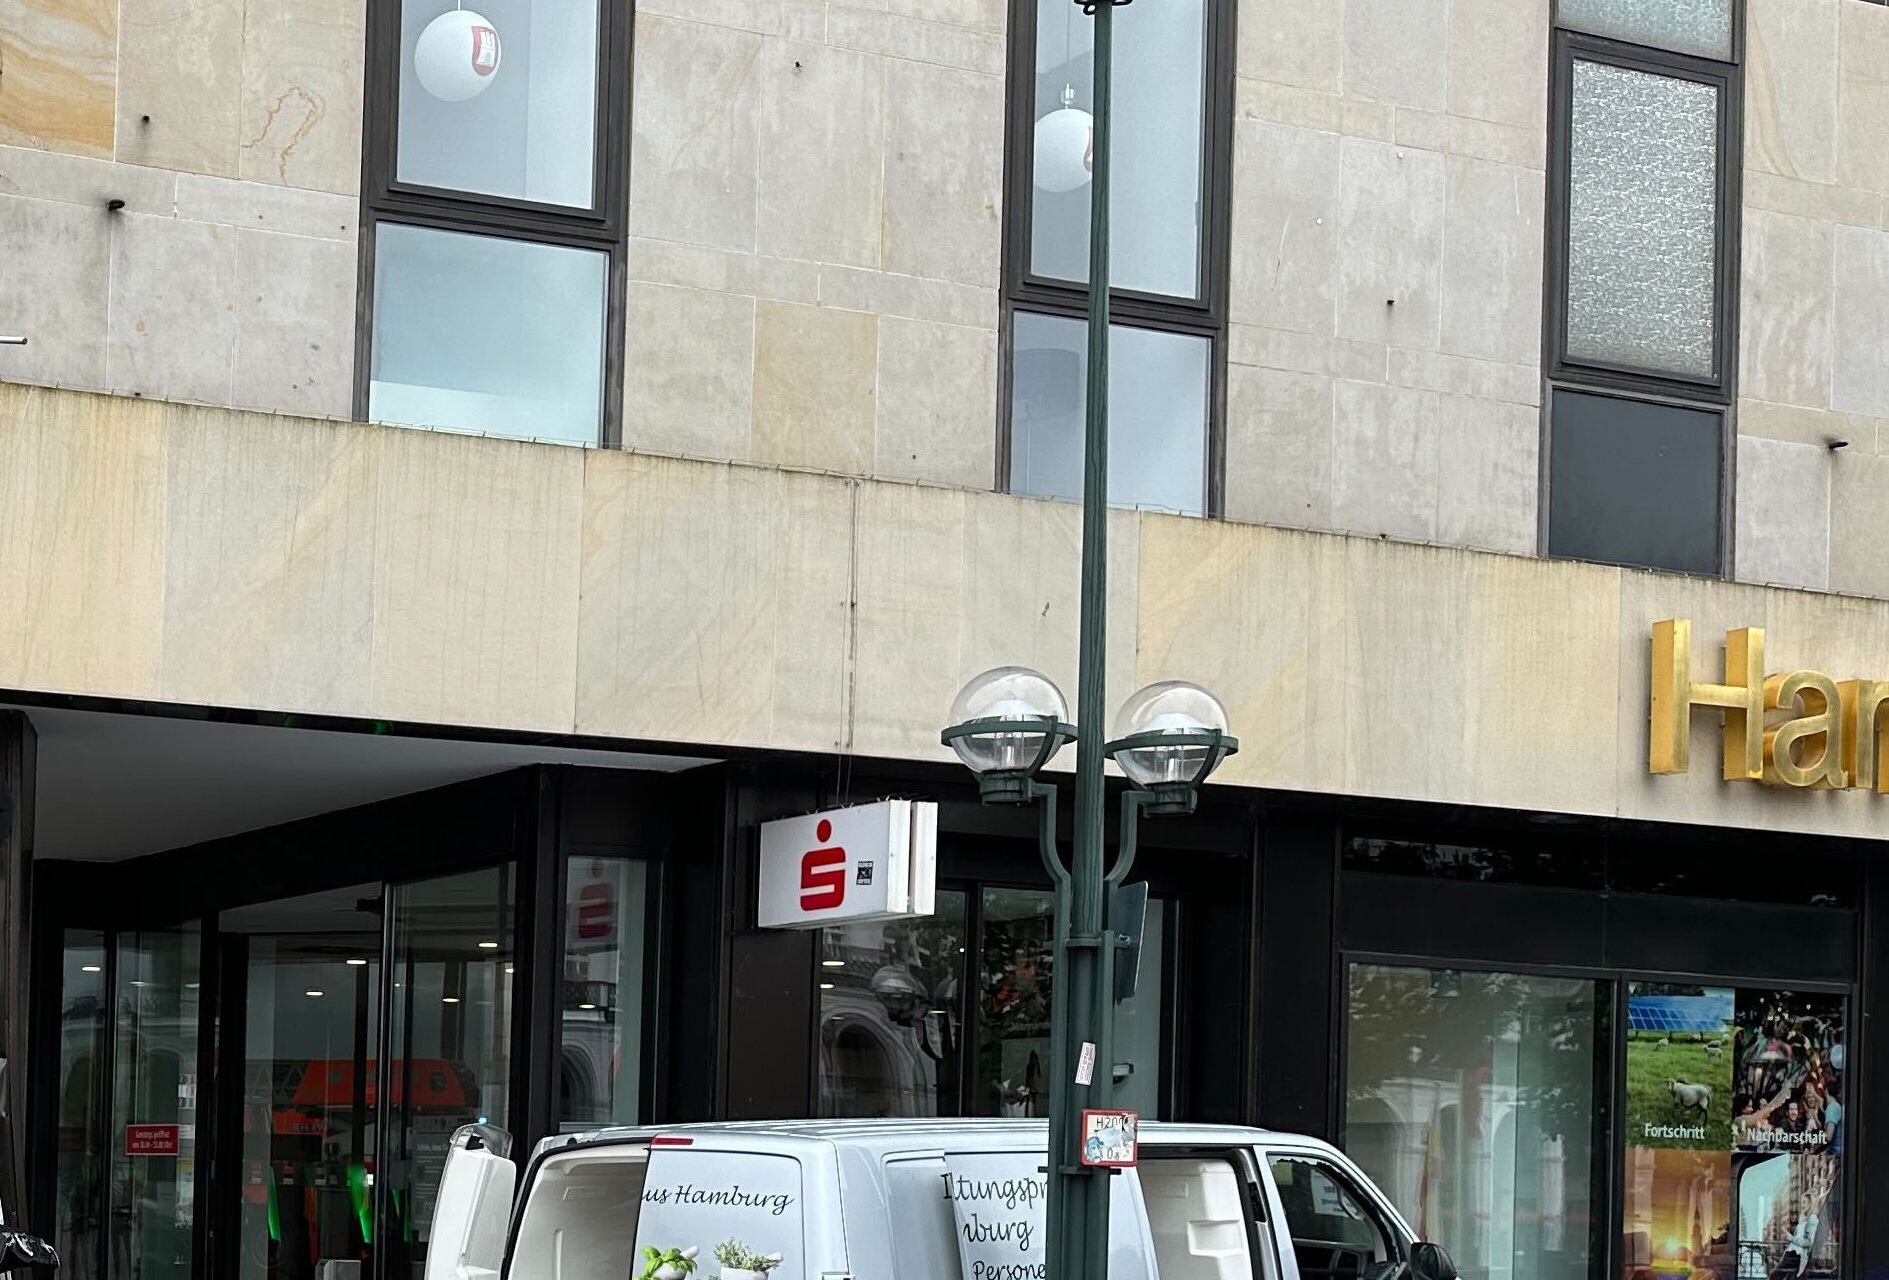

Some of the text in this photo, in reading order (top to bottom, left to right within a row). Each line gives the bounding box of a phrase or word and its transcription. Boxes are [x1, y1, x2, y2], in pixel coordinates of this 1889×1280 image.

[1644, 1123, 1705, 1139] Fortschritt
[1747, 1128, 1827, 1144] Nachbarschaft
[675, 1184, 794, 1216] Hamburg
